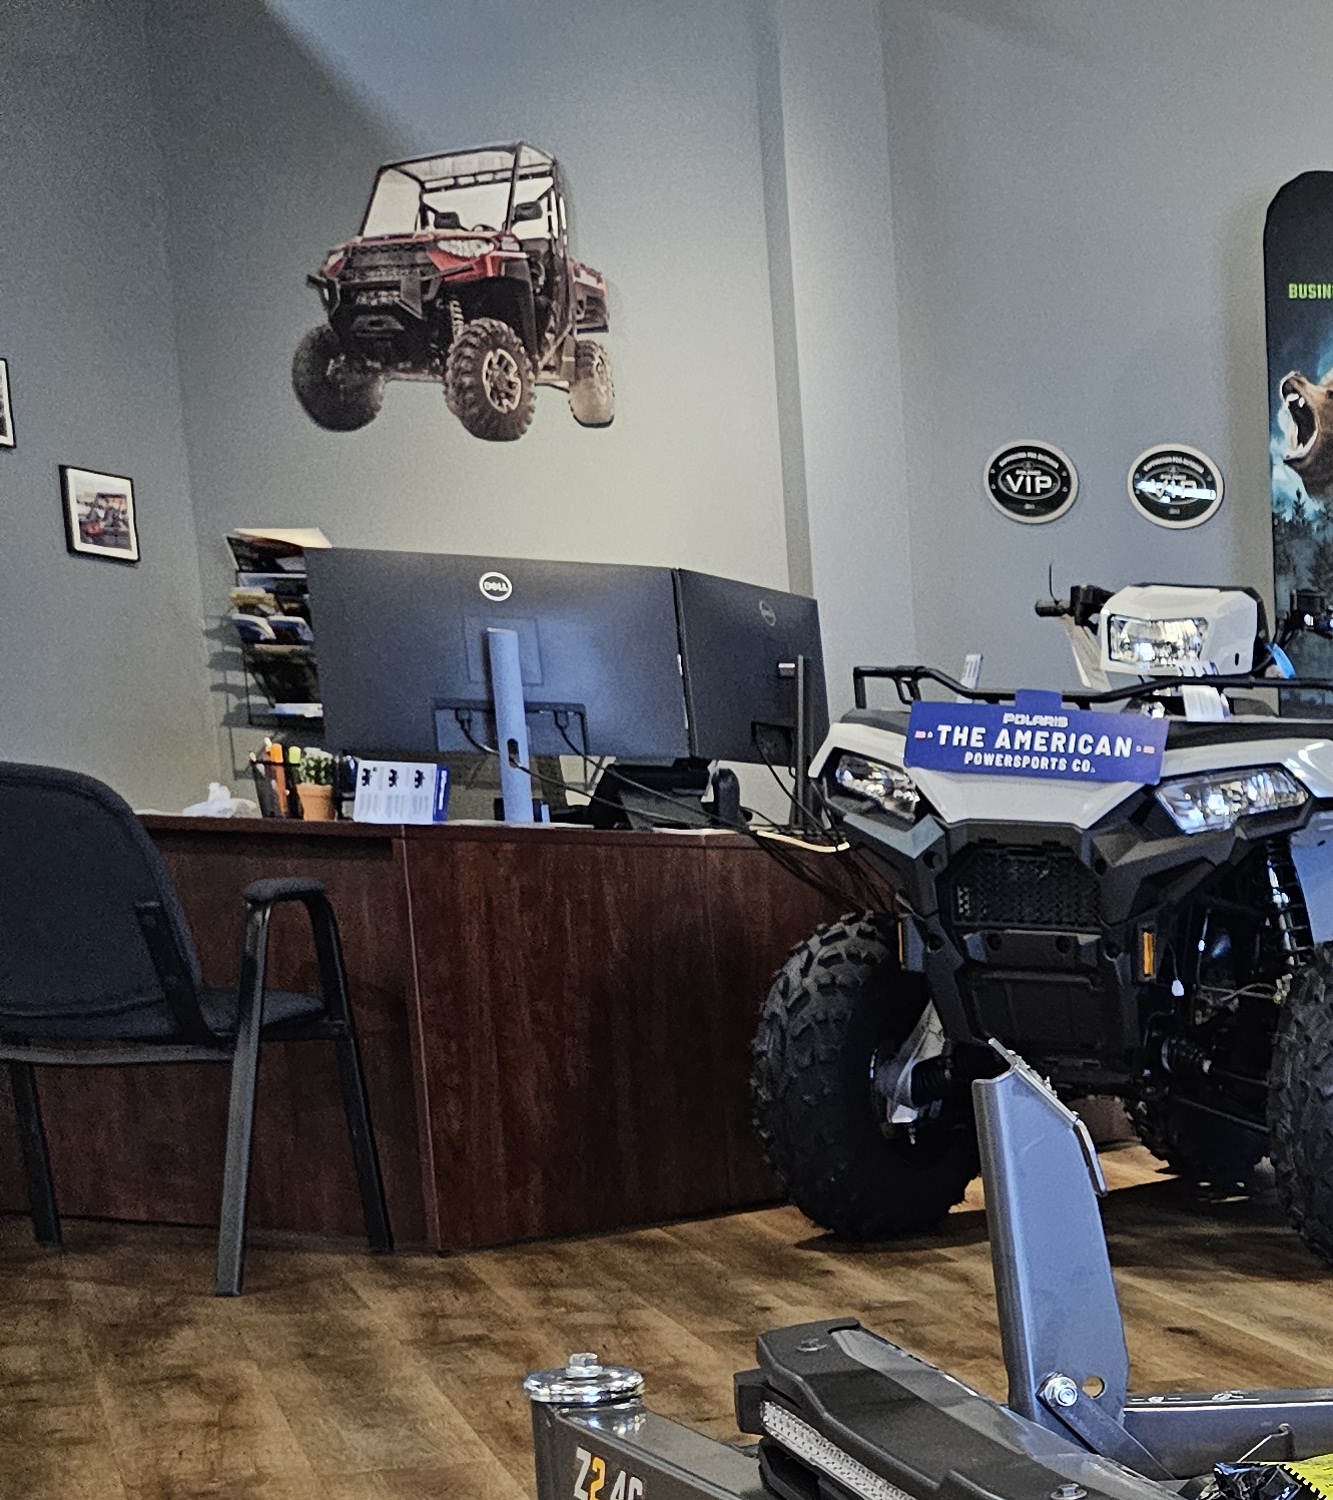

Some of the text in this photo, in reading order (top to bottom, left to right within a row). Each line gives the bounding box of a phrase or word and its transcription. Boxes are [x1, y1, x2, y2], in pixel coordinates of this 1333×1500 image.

[1005, 474, 1053, 494] VIP
[1003, 712, 1069, 729] POLARIS
[936, 724, 1133, 758] THE AMERICAN
[963, 751, 1096, 774] POWERSPORTS CO.
